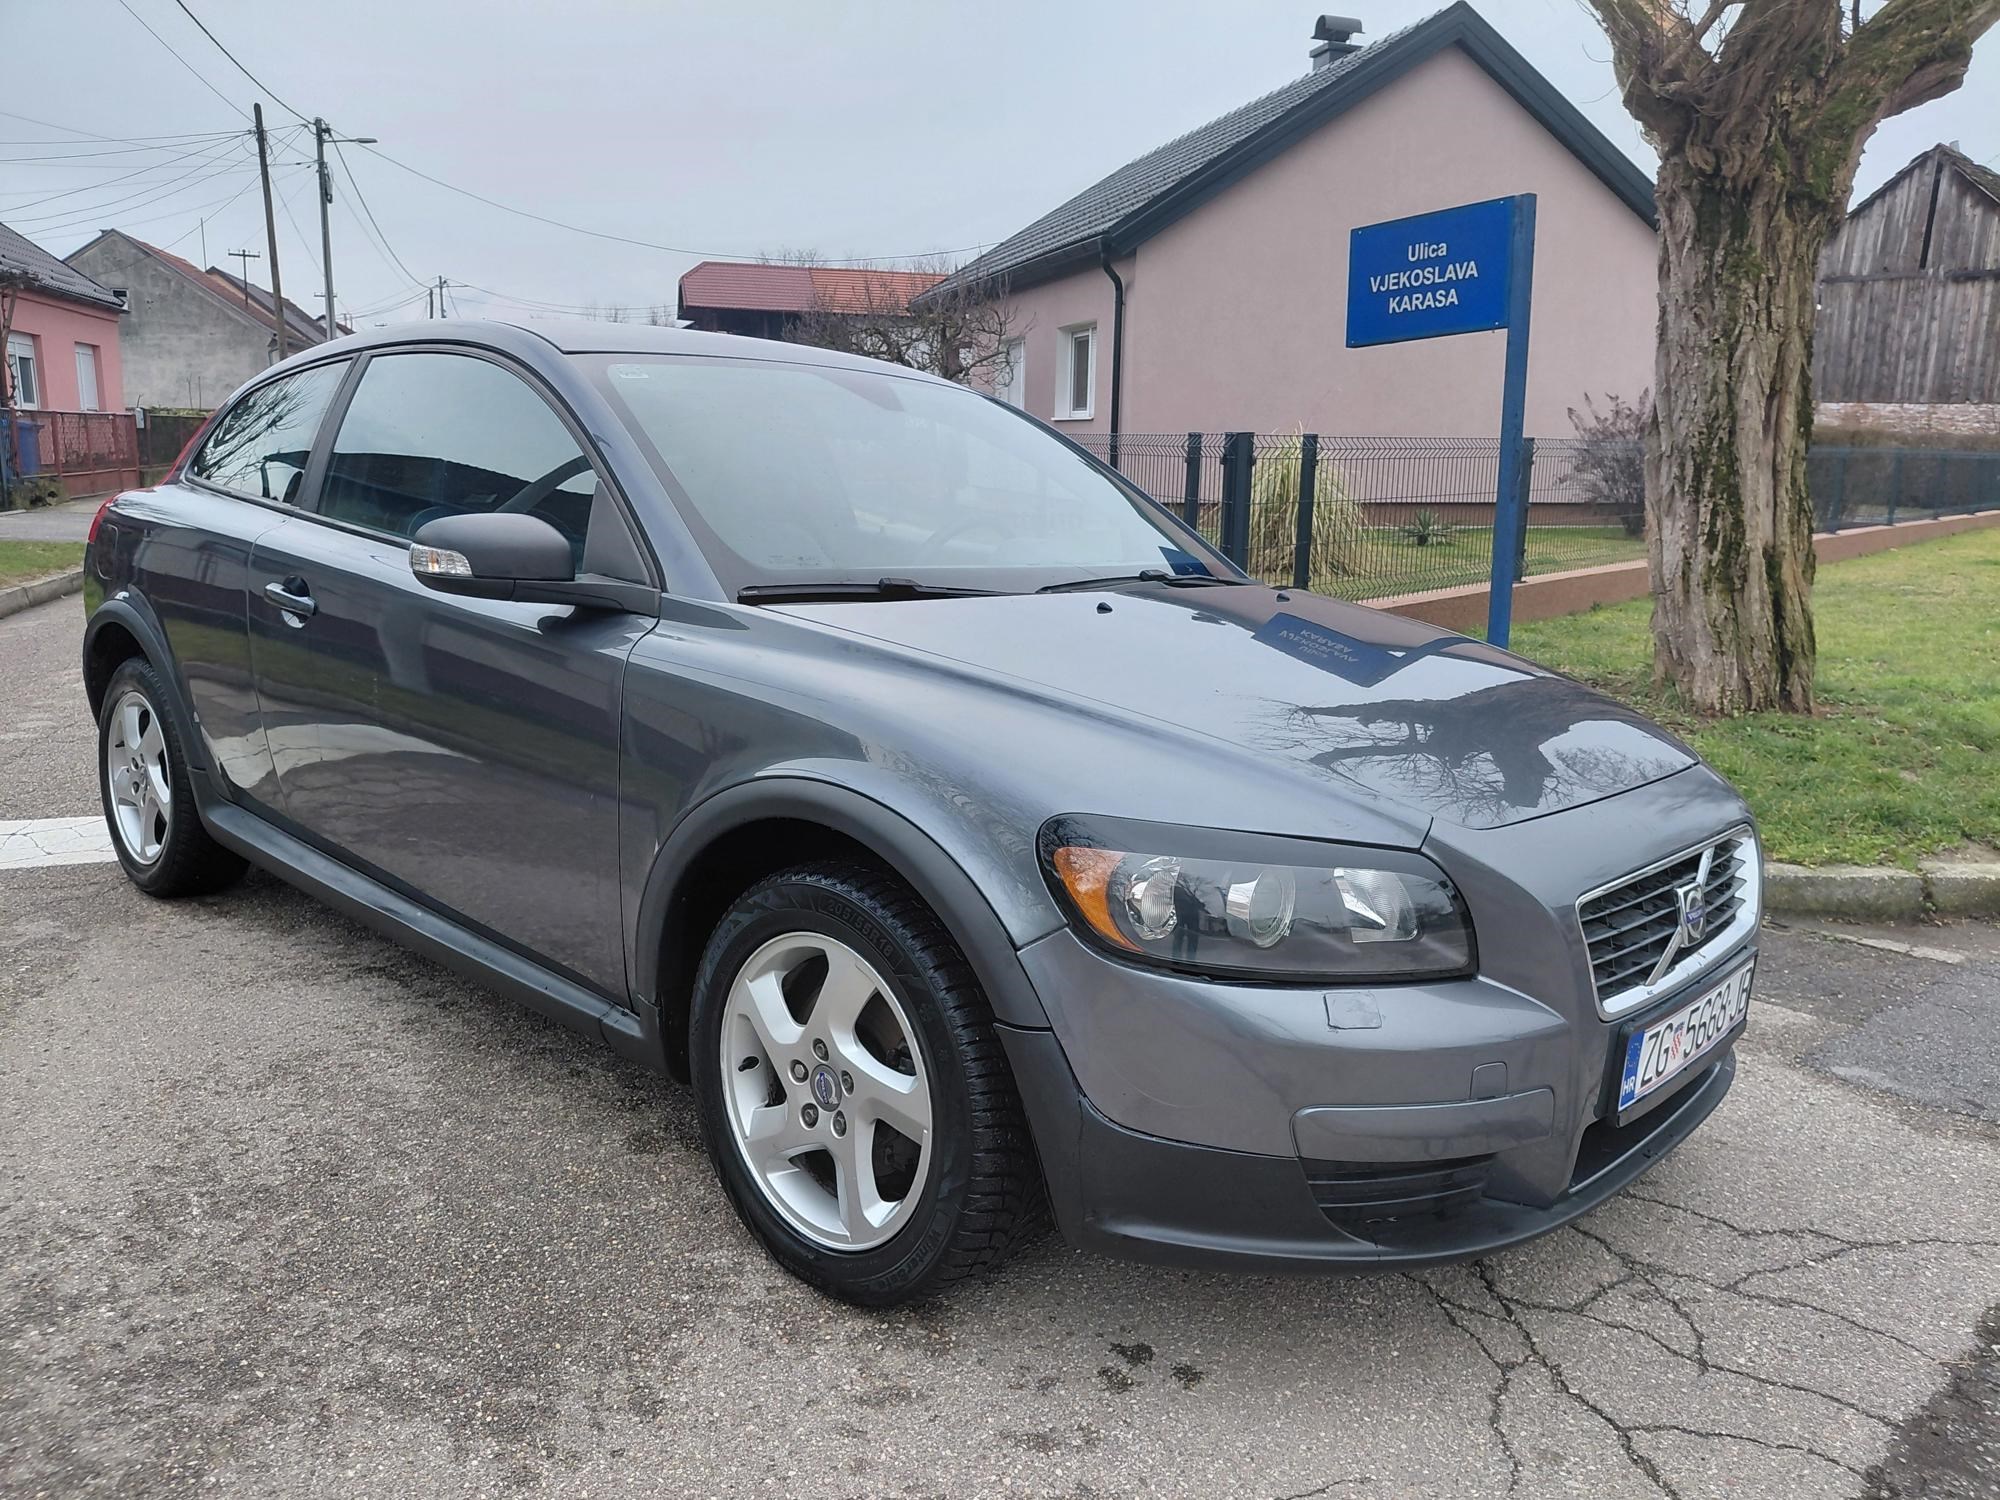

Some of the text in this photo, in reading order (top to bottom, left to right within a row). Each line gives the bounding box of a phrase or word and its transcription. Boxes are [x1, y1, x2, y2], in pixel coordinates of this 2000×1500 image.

[1407, 242, 1447, 262] Ulica
[1370, 260, 1479, 293] VJEKOSLAVA
[1388, 288, 1459, 314] KARASA
[1640, 1022, 1674, 1088] ZG
[1621, 1075, 1636, 1097] HR
